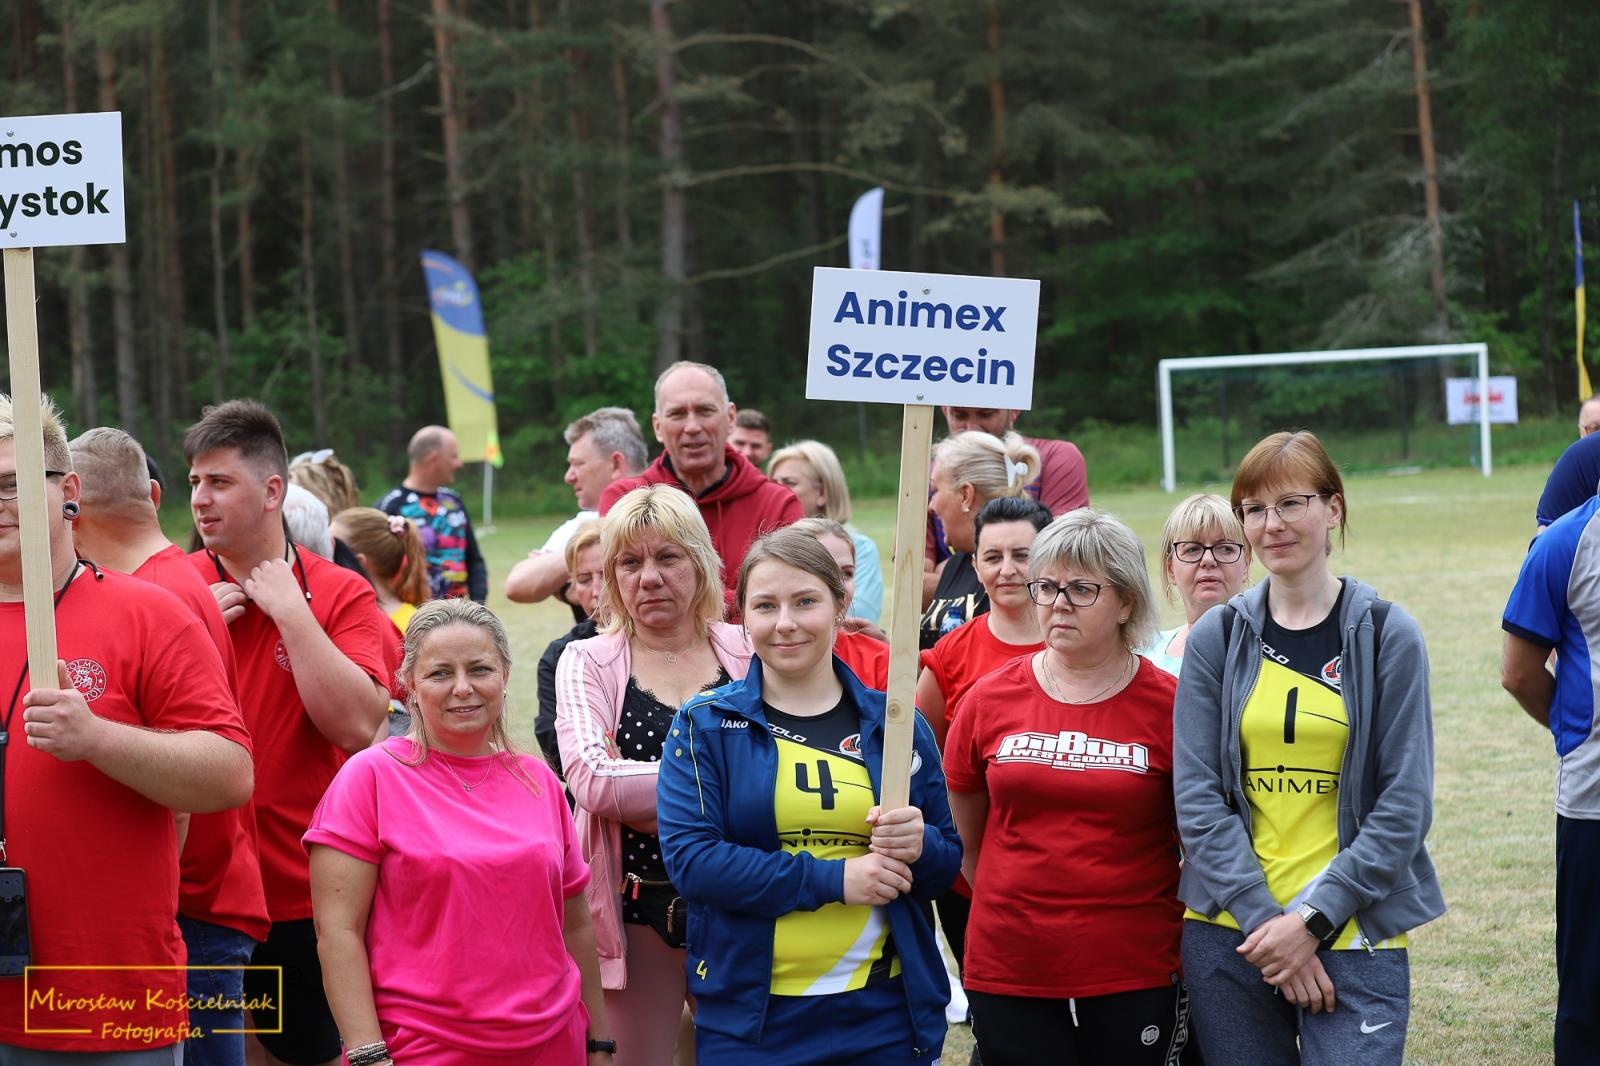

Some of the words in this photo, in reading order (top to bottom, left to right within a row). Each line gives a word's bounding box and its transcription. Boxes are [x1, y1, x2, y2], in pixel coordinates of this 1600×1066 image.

[833, 289, 1008, 333] Animex
[826, 343, 1016, 386] Szczecin
[1262, 642, 1290, 664] OLO
[1011, 749, 1064, 761] WEST
[1067, 754, 1133, 765] COAST
[794, 759, 839, 810] 4
[696, 959, 708, 981] 4
